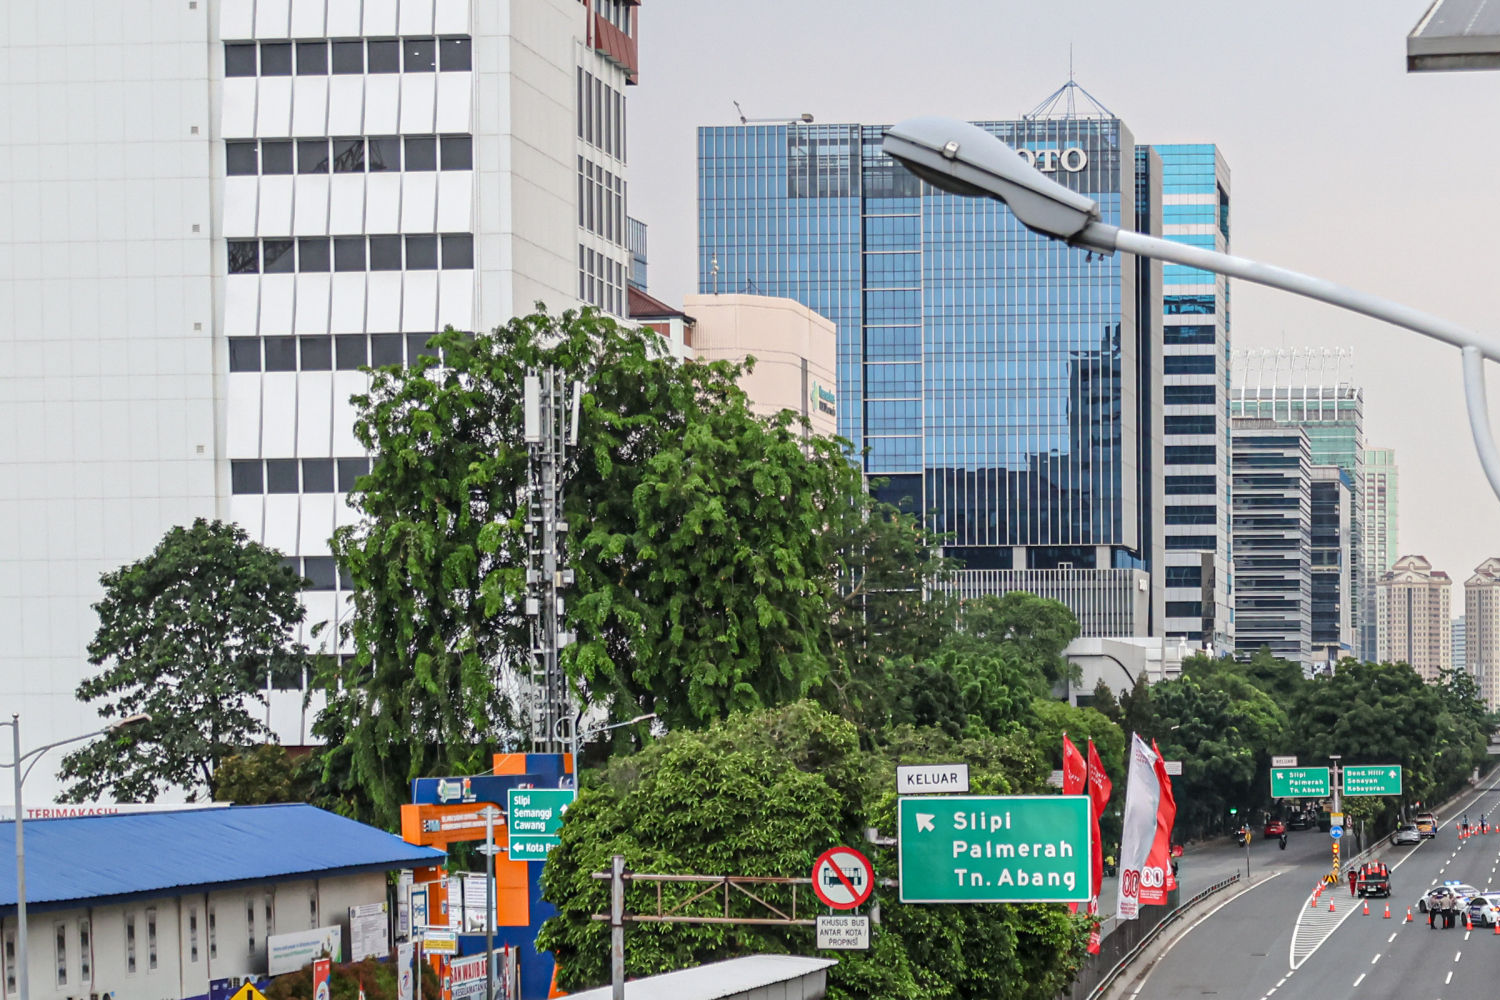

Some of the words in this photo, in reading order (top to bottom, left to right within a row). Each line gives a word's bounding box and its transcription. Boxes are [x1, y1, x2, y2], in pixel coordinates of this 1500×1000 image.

[907, 773, 958, 785] KELUAR
[1302, 787, 1325, 795] Abang
[514, 795, 530, 807] Slipi
[514, 808, 552, 820] Semanggi
[514, 820, 546, 832] Cawang
[953, 811, 1011, 833] Slipi
[526, 842, 544, 853] Kota
[952, 840, 1073, 858] Palmerah
[954, 868, 991, 886] Tn.
[997, 868, 1076, 891] Abang
[821, 919, 848, 927] KHUSUS
[851, 919, 865, 927] BUS
[820, 929, 841, 937] ANTAR
[845, 928, 862, 937] KOTA
[828, 937, 859, 946] PROPINSI
